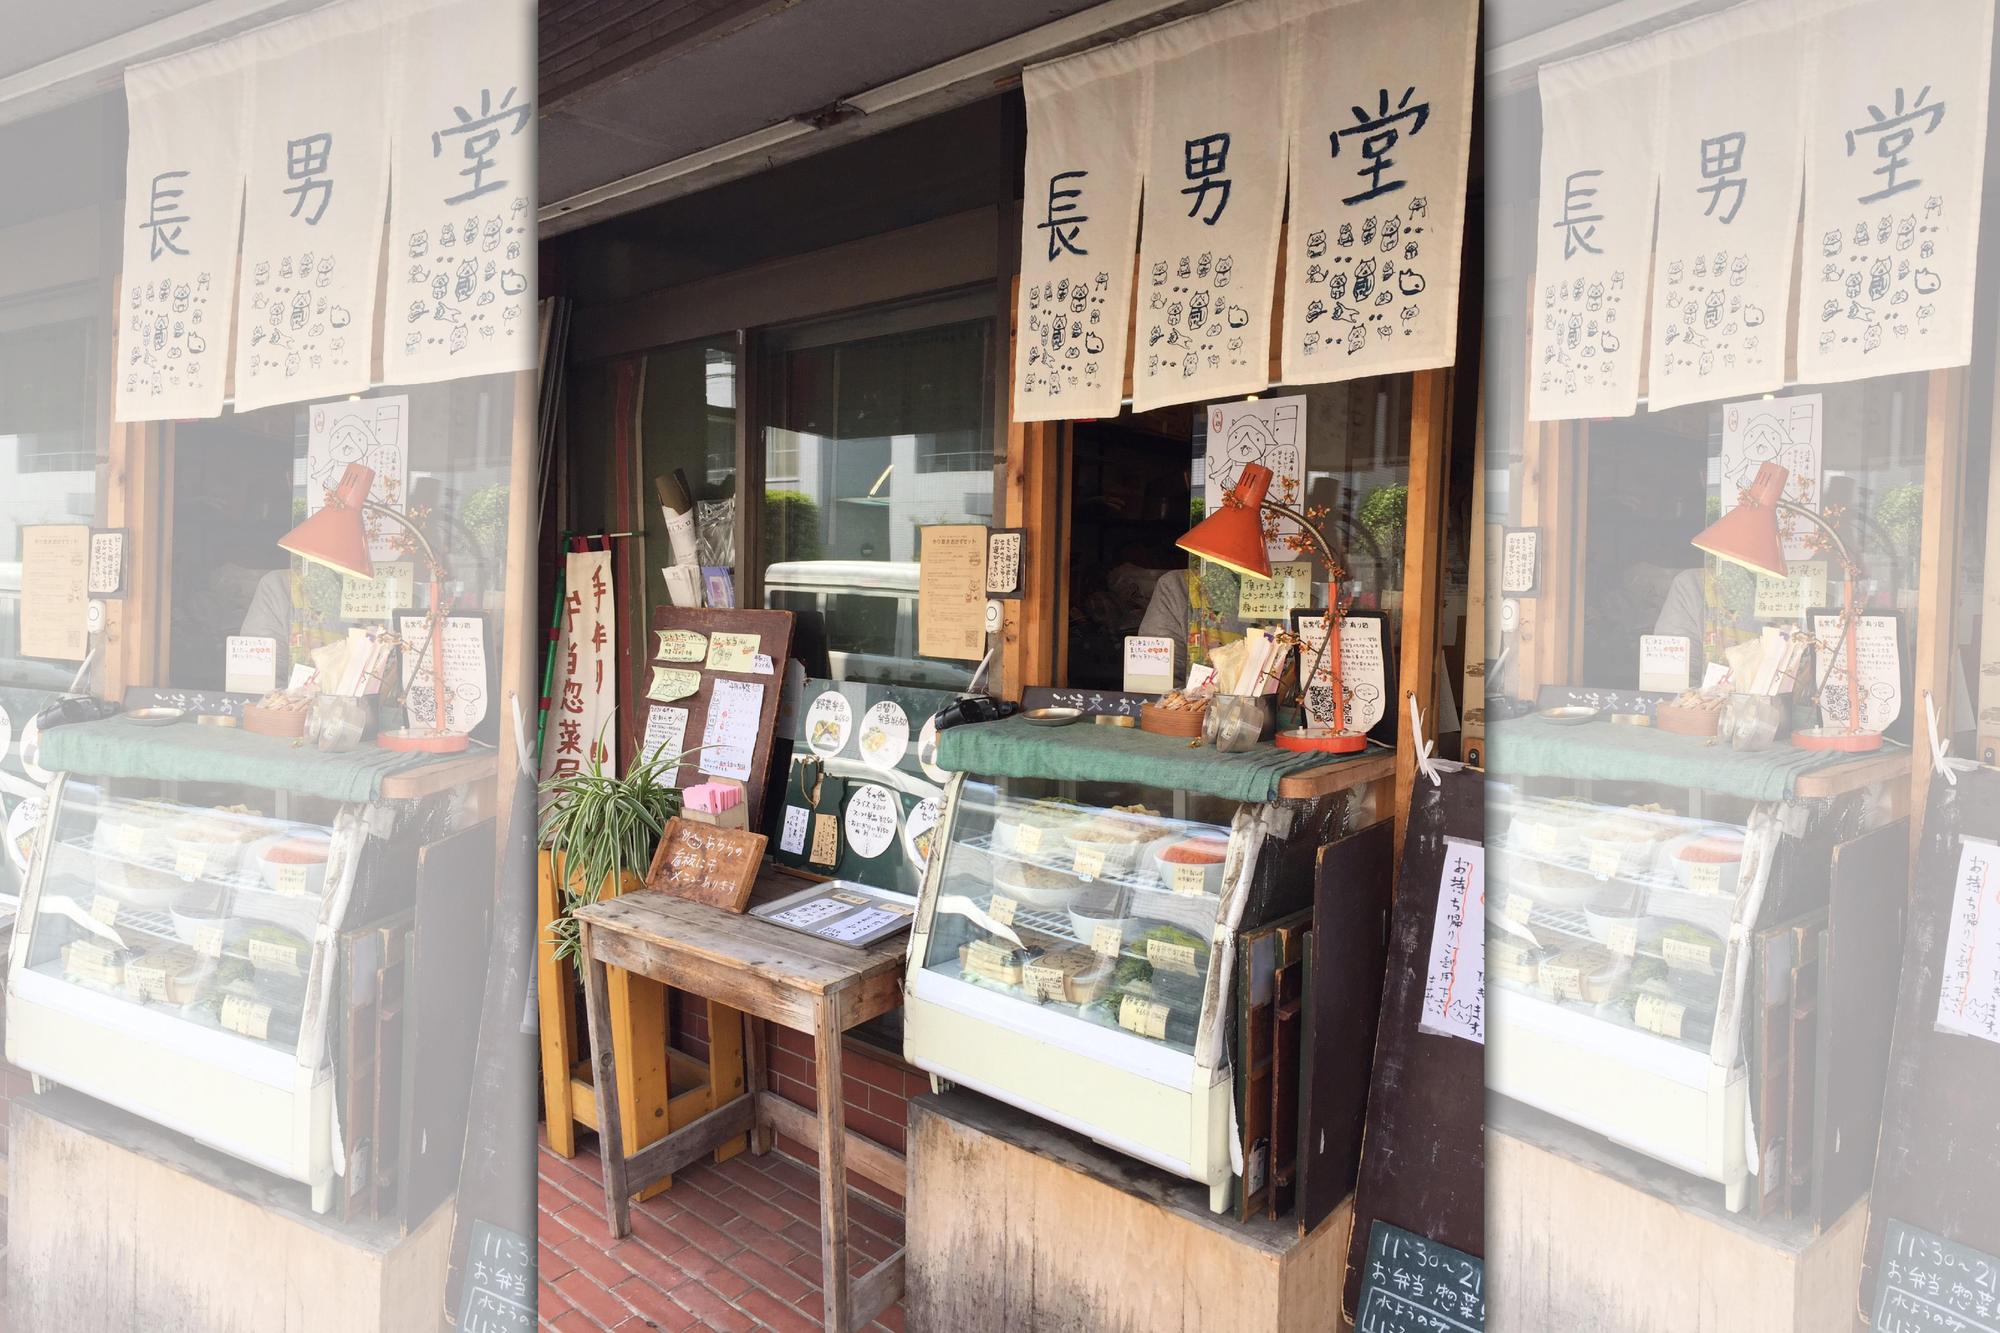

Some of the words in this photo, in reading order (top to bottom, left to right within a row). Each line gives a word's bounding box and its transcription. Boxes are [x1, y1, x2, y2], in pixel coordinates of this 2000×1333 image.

[1037, 87, 1430, 261] 長男堂
[1273, 565, 1308, 578] お選び
[591, 564, 608, 694] 手作り
[815, 698, 845, 713] 野菜弁当
[876, 703, 897, 714] 日替り
[866, 786, 887, 802] その他
[705, 834, 743, 857] あちらの
[671, 847, 718, 873] 看板にも
[671, 870, 737, 895] メニューあります
[1372, 1261, 1484, 1321] お弁当・惣菜
